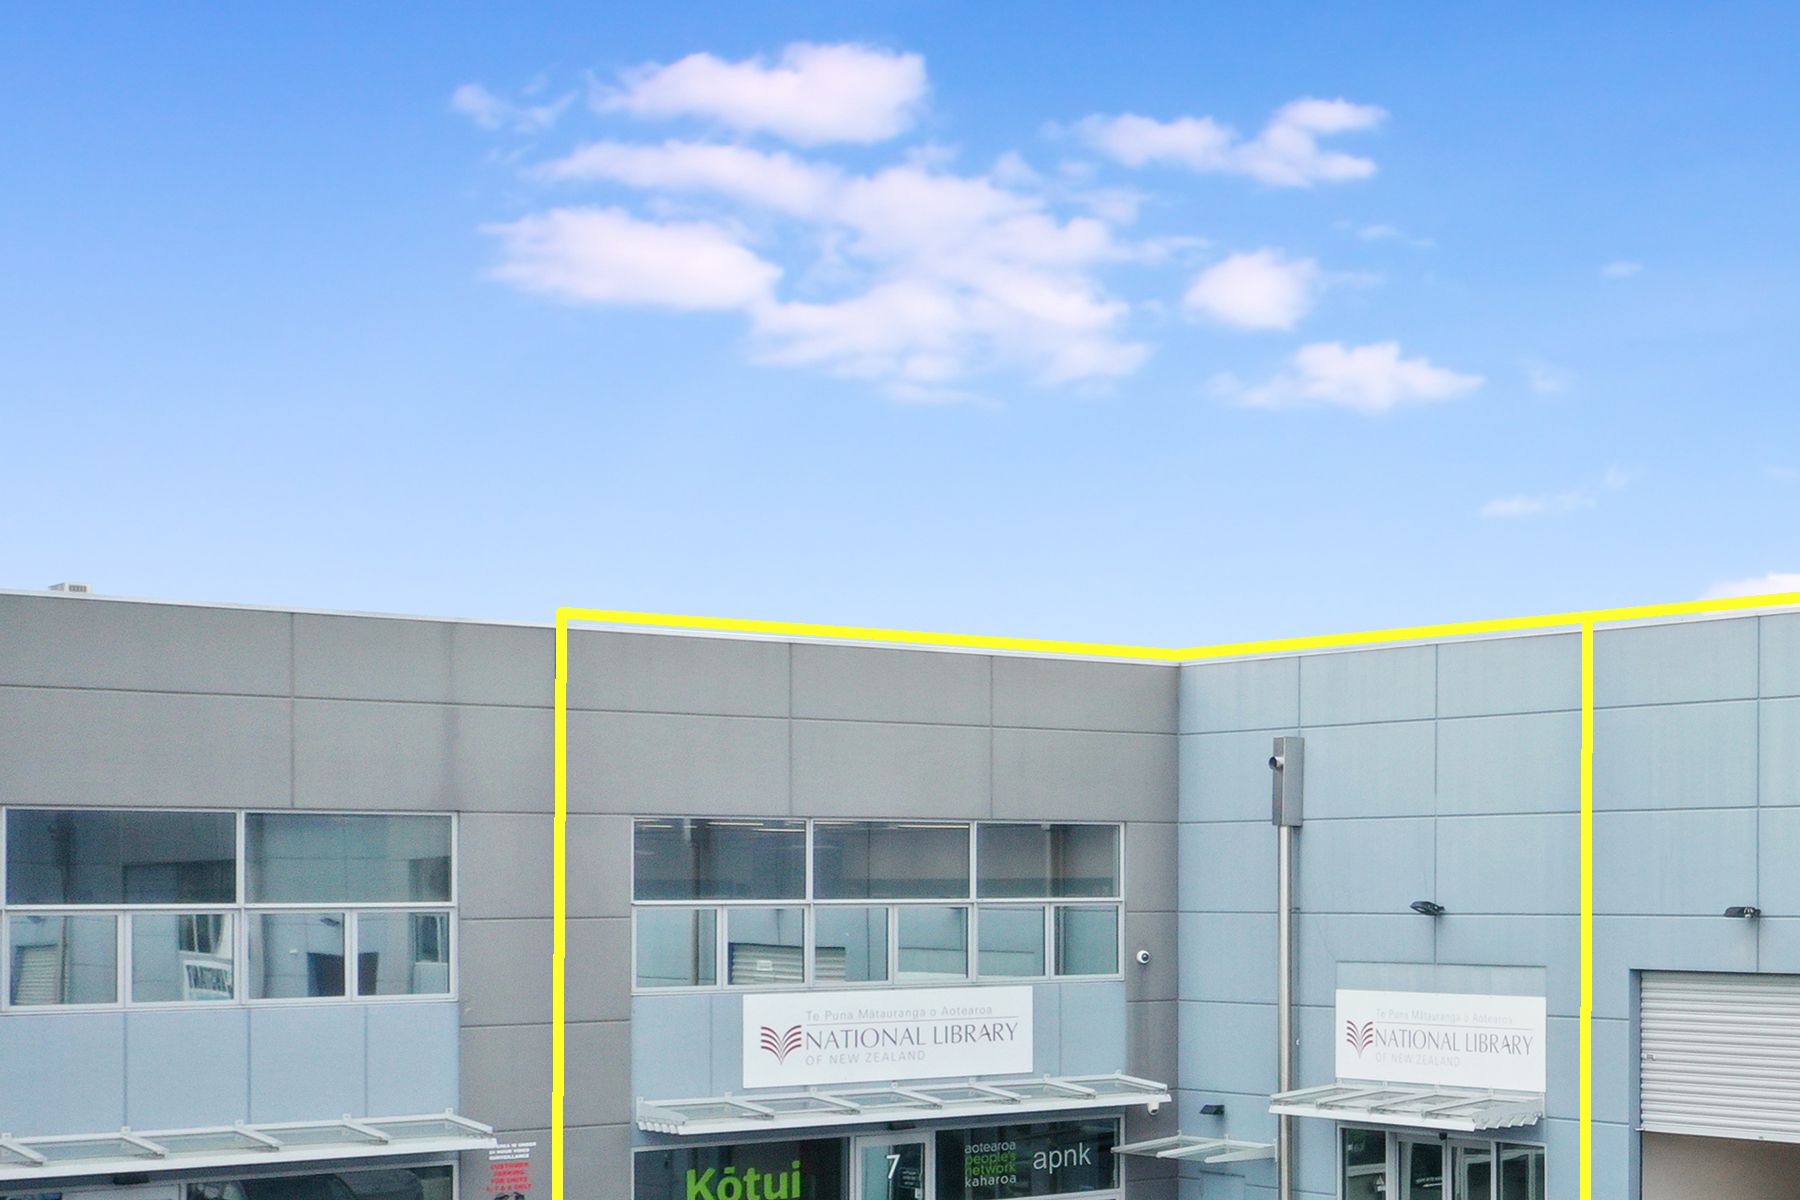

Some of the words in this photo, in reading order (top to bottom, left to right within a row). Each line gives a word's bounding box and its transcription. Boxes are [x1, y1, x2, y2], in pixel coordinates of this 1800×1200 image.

[807, 1011, 820, 1022] Te
[824, 1010, 854, 1021] Puna
[930, 1009, 937, 1017] o
[941, 1005, 992, 1016] Aotearoa
[1376, 1009, 1386, 1018] Te
[1389, 1010, 1409, 1020] Puna
[1472, 1014, 1513, 1025] Aotearoa
[805, 1027, 926, 1051] NATIONAL
[934, 1022, 1018, 1045] LIBRARY
[1376, 1029, 1461, 1052] NATIONAL
[1465, 1033, 1533, 1056] LIBRARY
[805, 1055, 823, 1066] OF
[829, 1053, 860, 1065] NEW
[865, 1050, 926, 1063] ZEALAND
[1376, 1054, 1387, 1063] OF
[1391, 1055, 1412, 1064] NEW
[1416, 1056, 1460, 1067] ZEALAND
[964, 1141, 1016, 1154] aotearoa
[965, 1151, 1016, 1165] people's
[1033, 1142, 1091, 1174] apnk
[886, 1154, 900, 1179] 7
[965, 1162, 1016, 1176] network
[965, 1174, 1017, 1188] kaharoa
